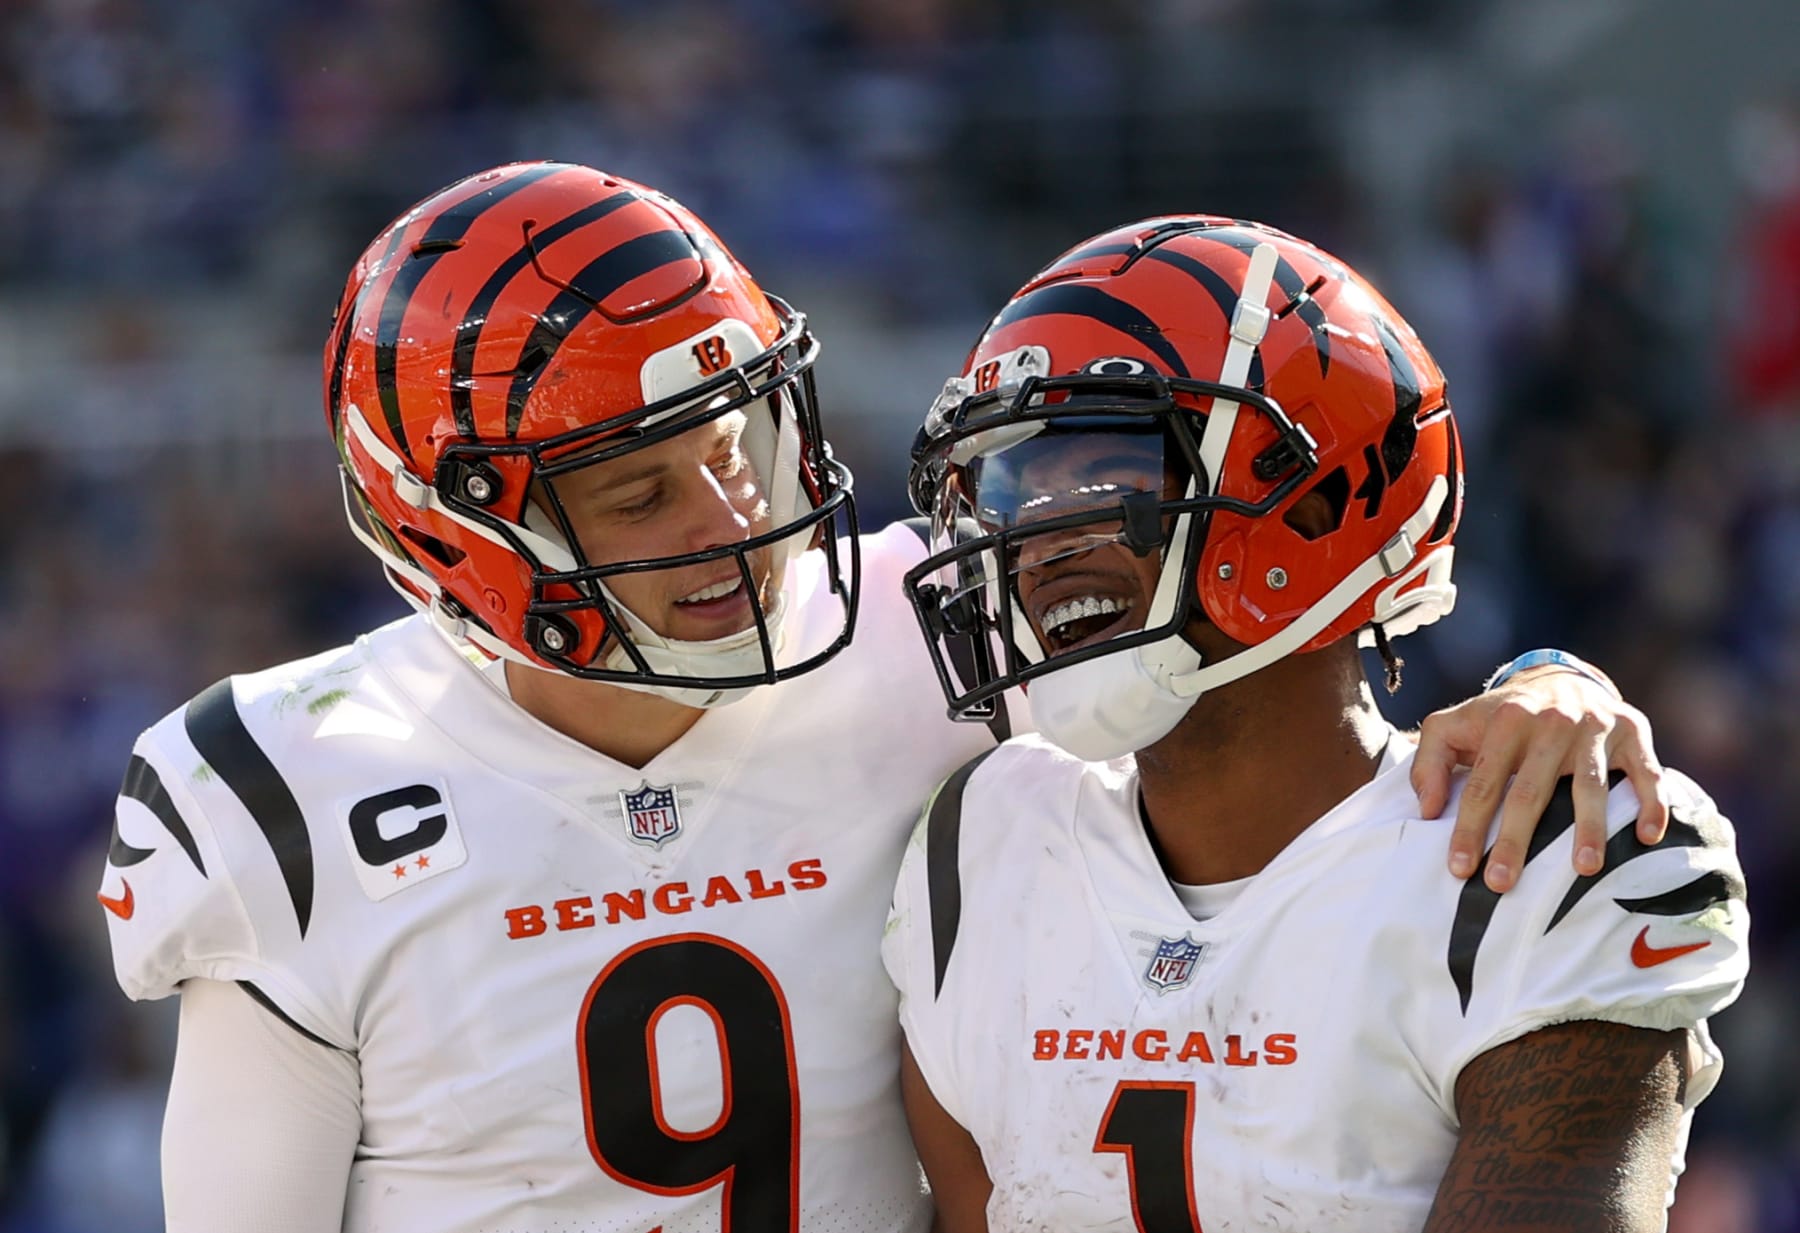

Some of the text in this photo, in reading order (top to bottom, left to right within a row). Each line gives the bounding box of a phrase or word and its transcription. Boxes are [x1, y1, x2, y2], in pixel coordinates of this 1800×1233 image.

[348, 784, 448, 867] C
[632, 808, 674, 836] NFL
[504, 858, 828, 940] BENGALS
[1151, 958, 1188, 983] NFL
[1032, 1028, 1299, 1066] BENGALS
